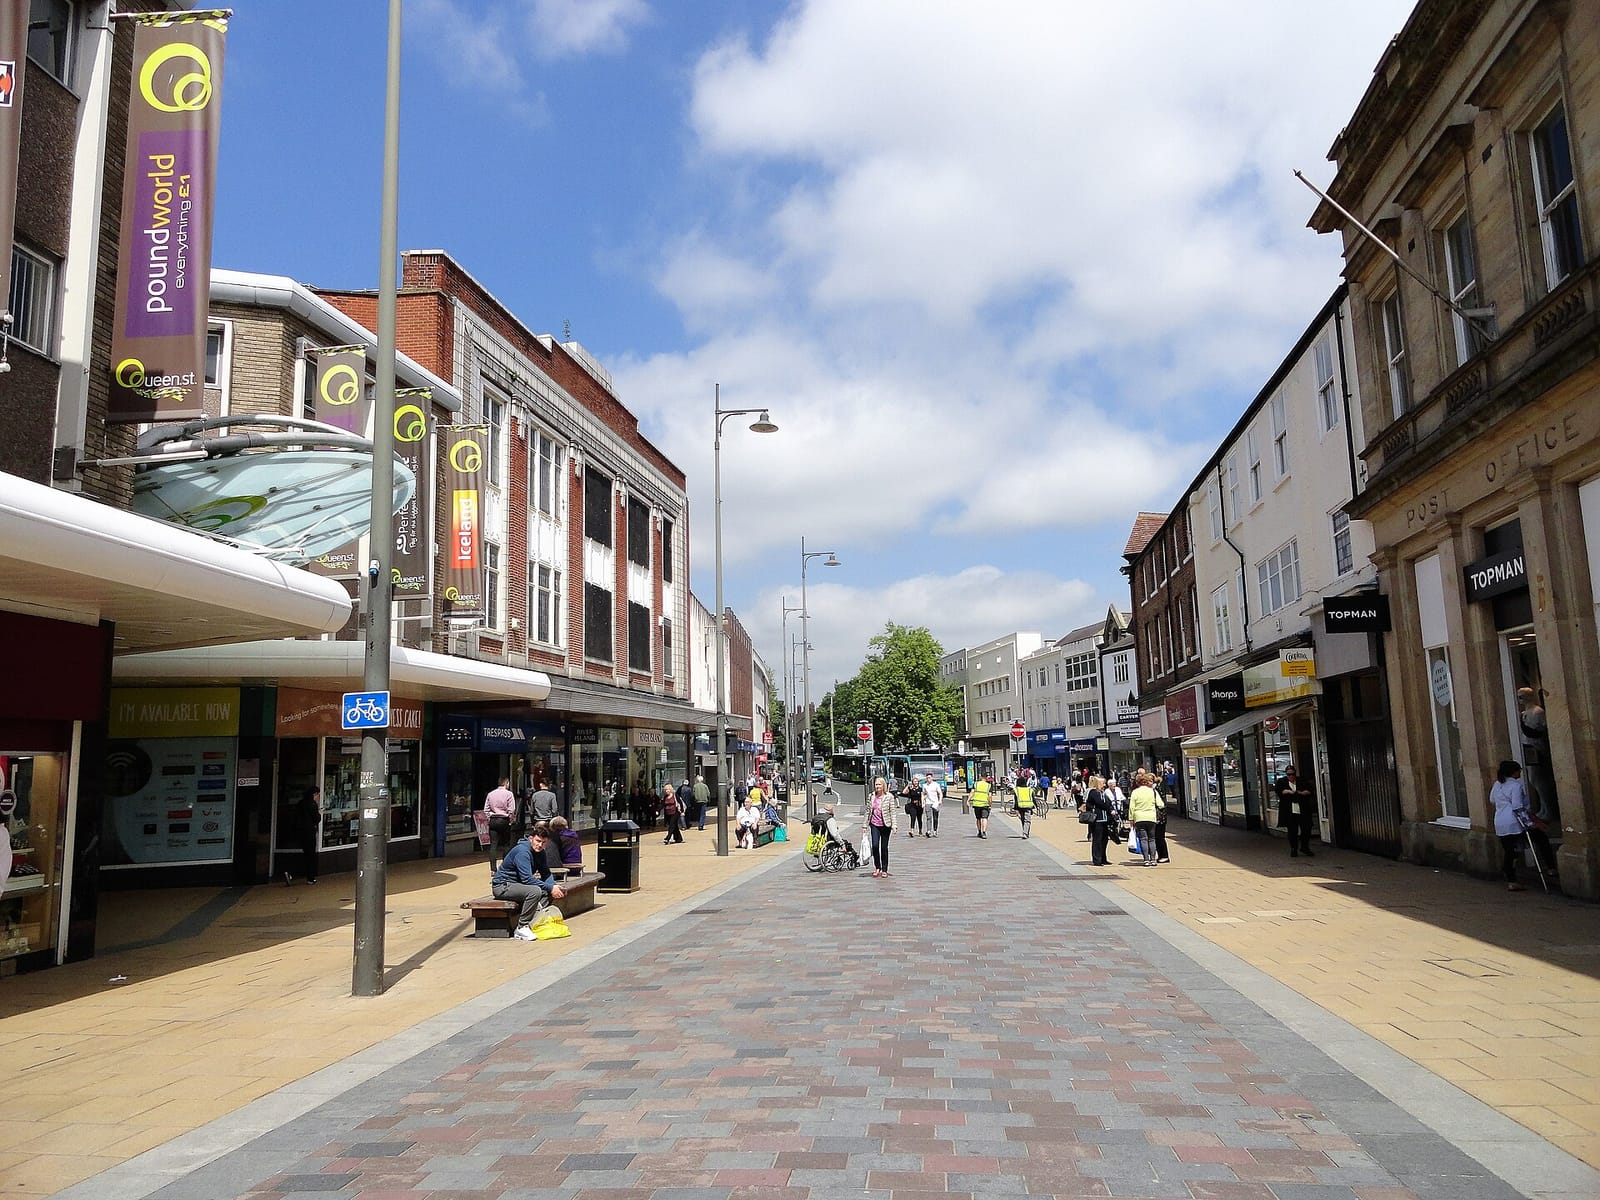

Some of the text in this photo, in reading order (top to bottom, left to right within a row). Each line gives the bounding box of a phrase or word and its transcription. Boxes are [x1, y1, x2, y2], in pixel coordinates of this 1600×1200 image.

[144, 153, 175, 312] poundworld
[175, 173, 191, 290] everything £1
[1406, 412, 1581, 528] POST OFFICE
[457, 498, 473, 560] Iceland
[1470, 556, 1524, 591] TOPMAN
[1327, 609, 1377, 620] TOPMAN
[1211, 690, 1238, 699] sharps
[119, 703, 231, 722] I'M AVAILABLE NOW
[280, 712, 302, 723] Looking
[483, 727, 512, 738] TRESPASS
